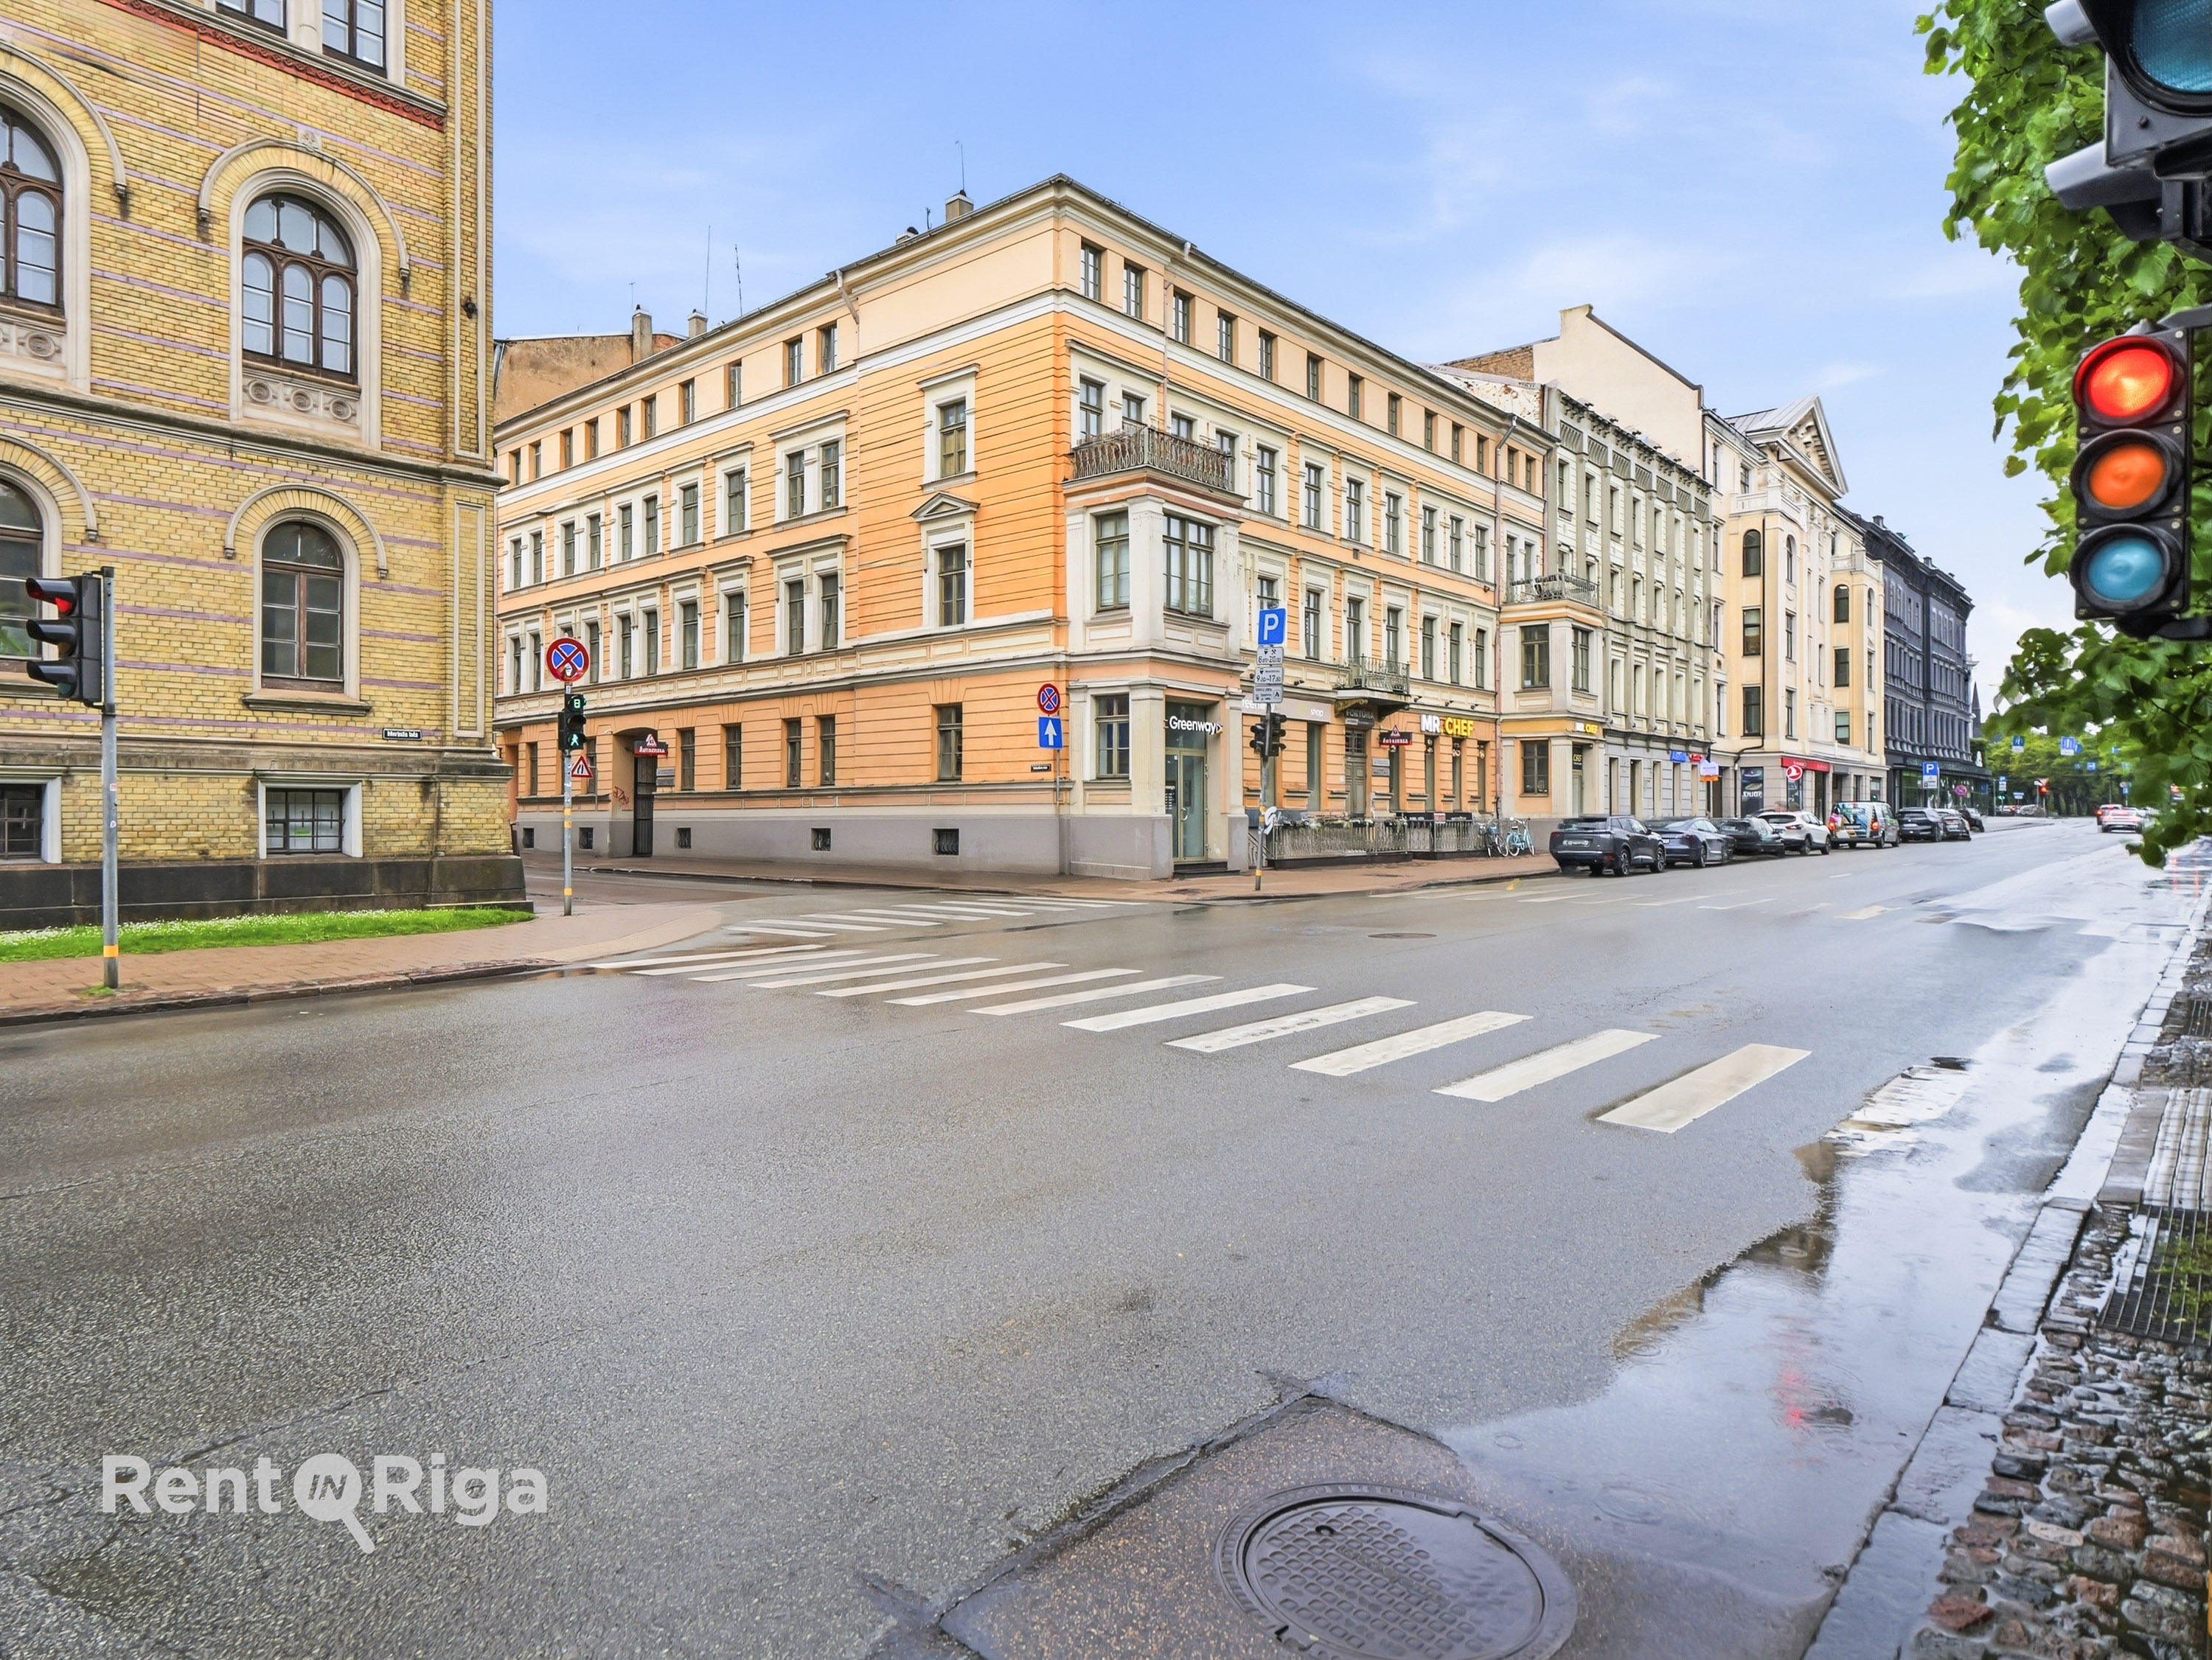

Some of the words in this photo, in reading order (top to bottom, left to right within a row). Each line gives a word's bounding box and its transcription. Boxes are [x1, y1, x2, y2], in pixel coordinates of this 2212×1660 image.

[1263, 613, 1279, 641] P
[1169, 716, 1216, 735] Greenway
[1445, 717, 1474, 736] CHEF
[1926, 764, 1935, 774] P
